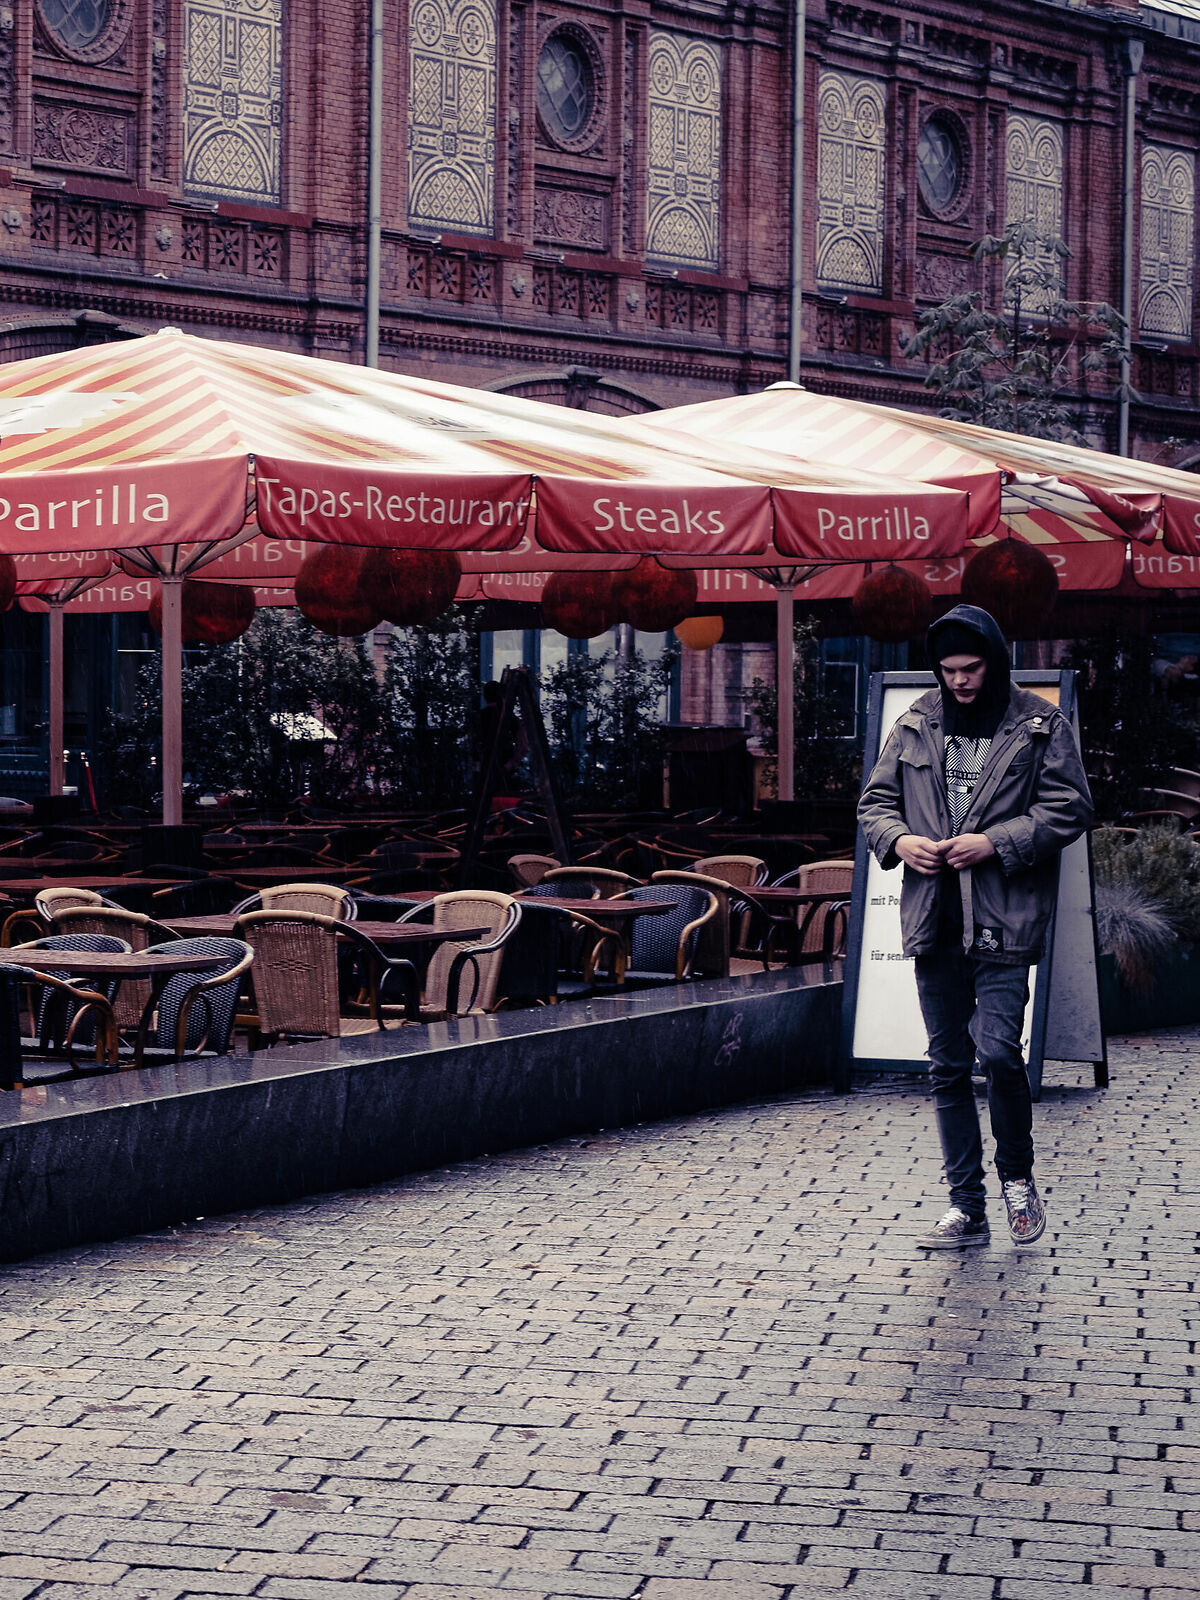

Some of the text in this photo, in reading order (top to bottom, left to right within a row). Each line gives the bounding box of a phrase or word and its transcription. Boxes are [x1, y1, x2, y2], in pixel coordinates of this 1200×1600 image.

[257, 477, 529, 527] Tapas-Restaurant
[593, 498, 726, 535] Steaks
[817, 507, 930, 541] Parrilla
[870, 895, 901, 906] mit Po
[871, 949, 886, 961] für
